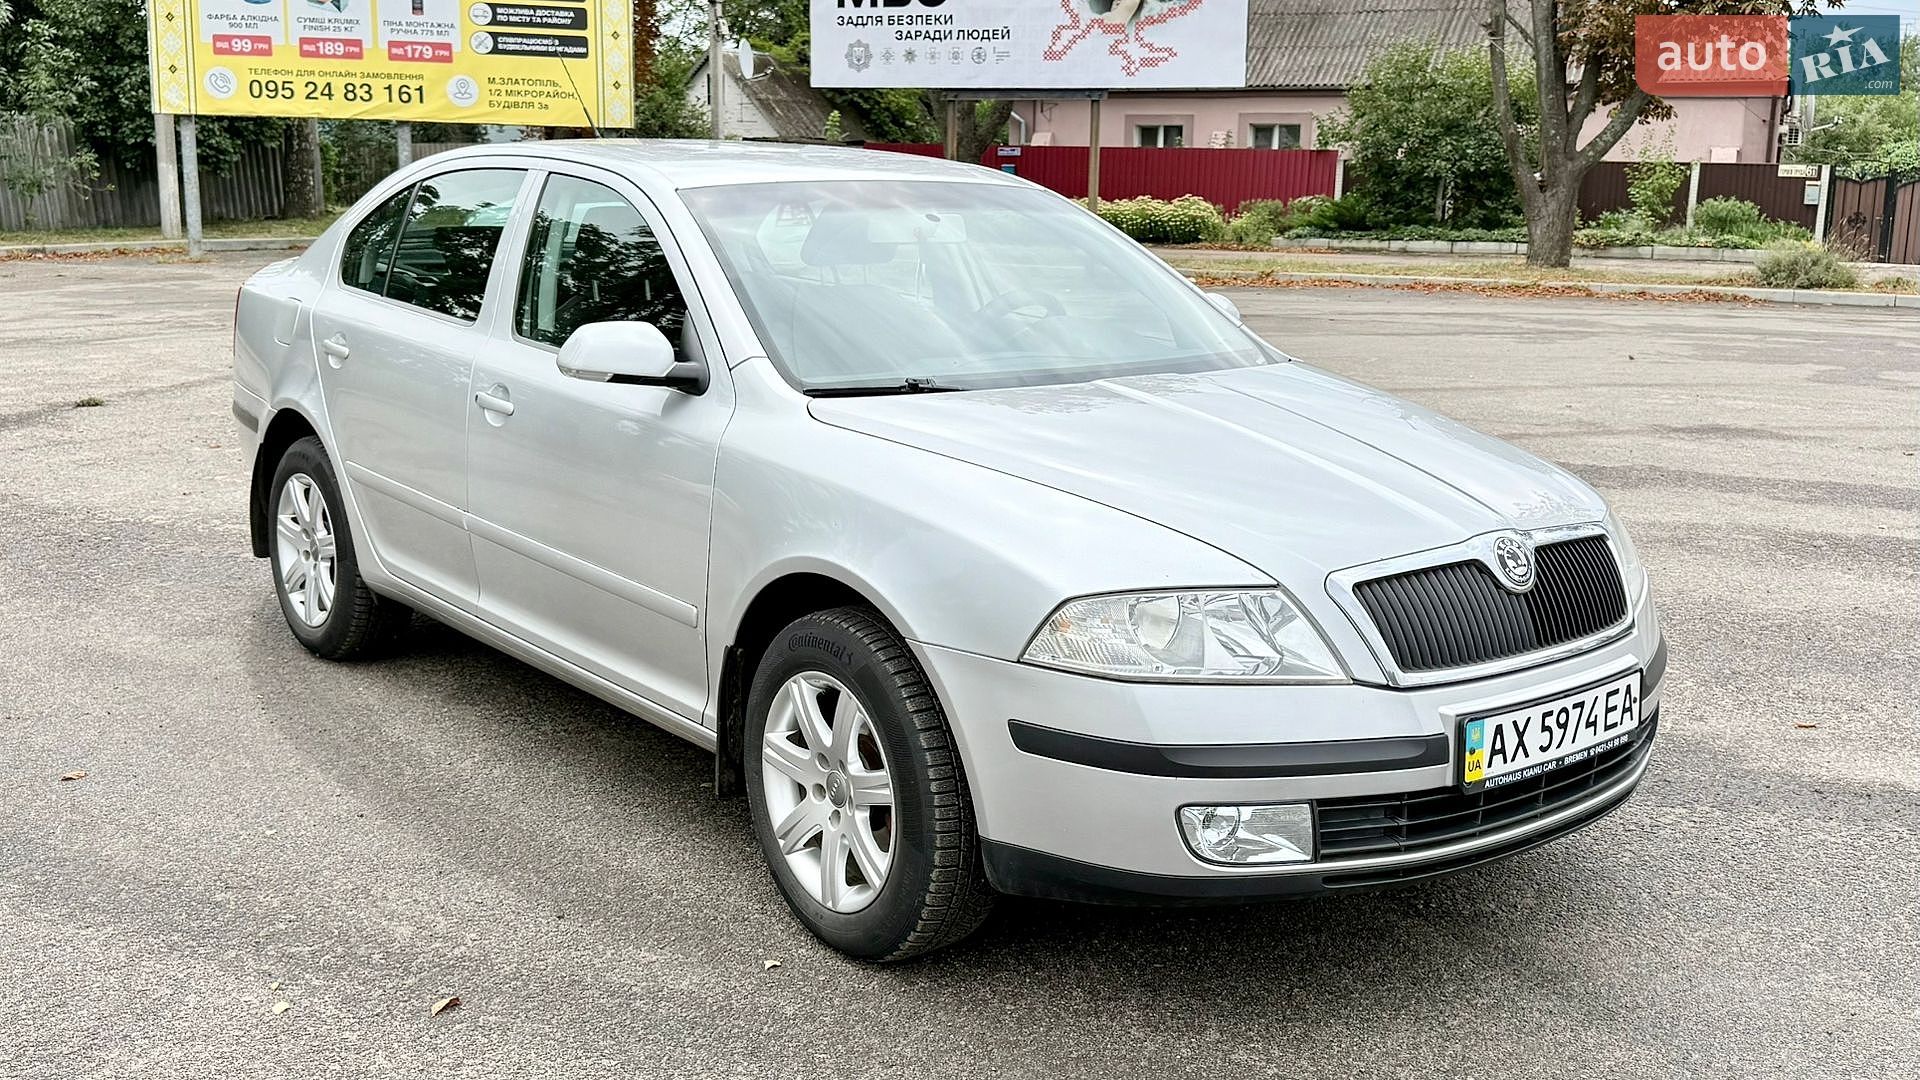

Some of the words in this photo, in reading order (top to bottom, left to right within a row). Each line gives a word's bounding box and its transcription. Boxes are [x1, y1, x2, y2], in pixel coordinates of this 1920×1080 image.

[206, 13, 238, 21] ФАРБА
[240, 14, 280, 22] АЛКІДНА
[836, 15, 884, 28] ЗАДЛЯ
[888, 14, 954, 26] БЕЗПЕКИ
[895, 29, 953, 42] ЗАРАДИ
[956, 26, 1011, 42] ЛЮДЕЙ
[231, 39, 252, 52] 99
[316, 42, 344, 55] 189
[404, 45, 433, 59] 179
[248, 68, 294, 76] ТЕЛЕФОН
[296, 70, 316, 78] ДЛЯ
[318, 69, 357, 78] ОНЛАЙН
[360, 72, 424, 81] ЗАМОВЛЕННЯ
[249, 80, 295, 100] 095
[304, 81, 334, 100] 24
[344, 82, 373, 102] 83
[383, 84, 424, 104] 161
[488, 89, 502, 97] 1/2
[489, 100, 534, 109] БУДІВЛЯ
[1487, 716, 1532, 769] AX
[1538, 696, 1599, 753] 5974
[1603, 684, 1634, 732] EA
[1467, 759, 1482, 772] UA
[1484, 771, 1522, 788] AUTOHAUS
[1543, 760, 1557, 772] CAR
[1564, 750, 1588, 765] BREMEN
